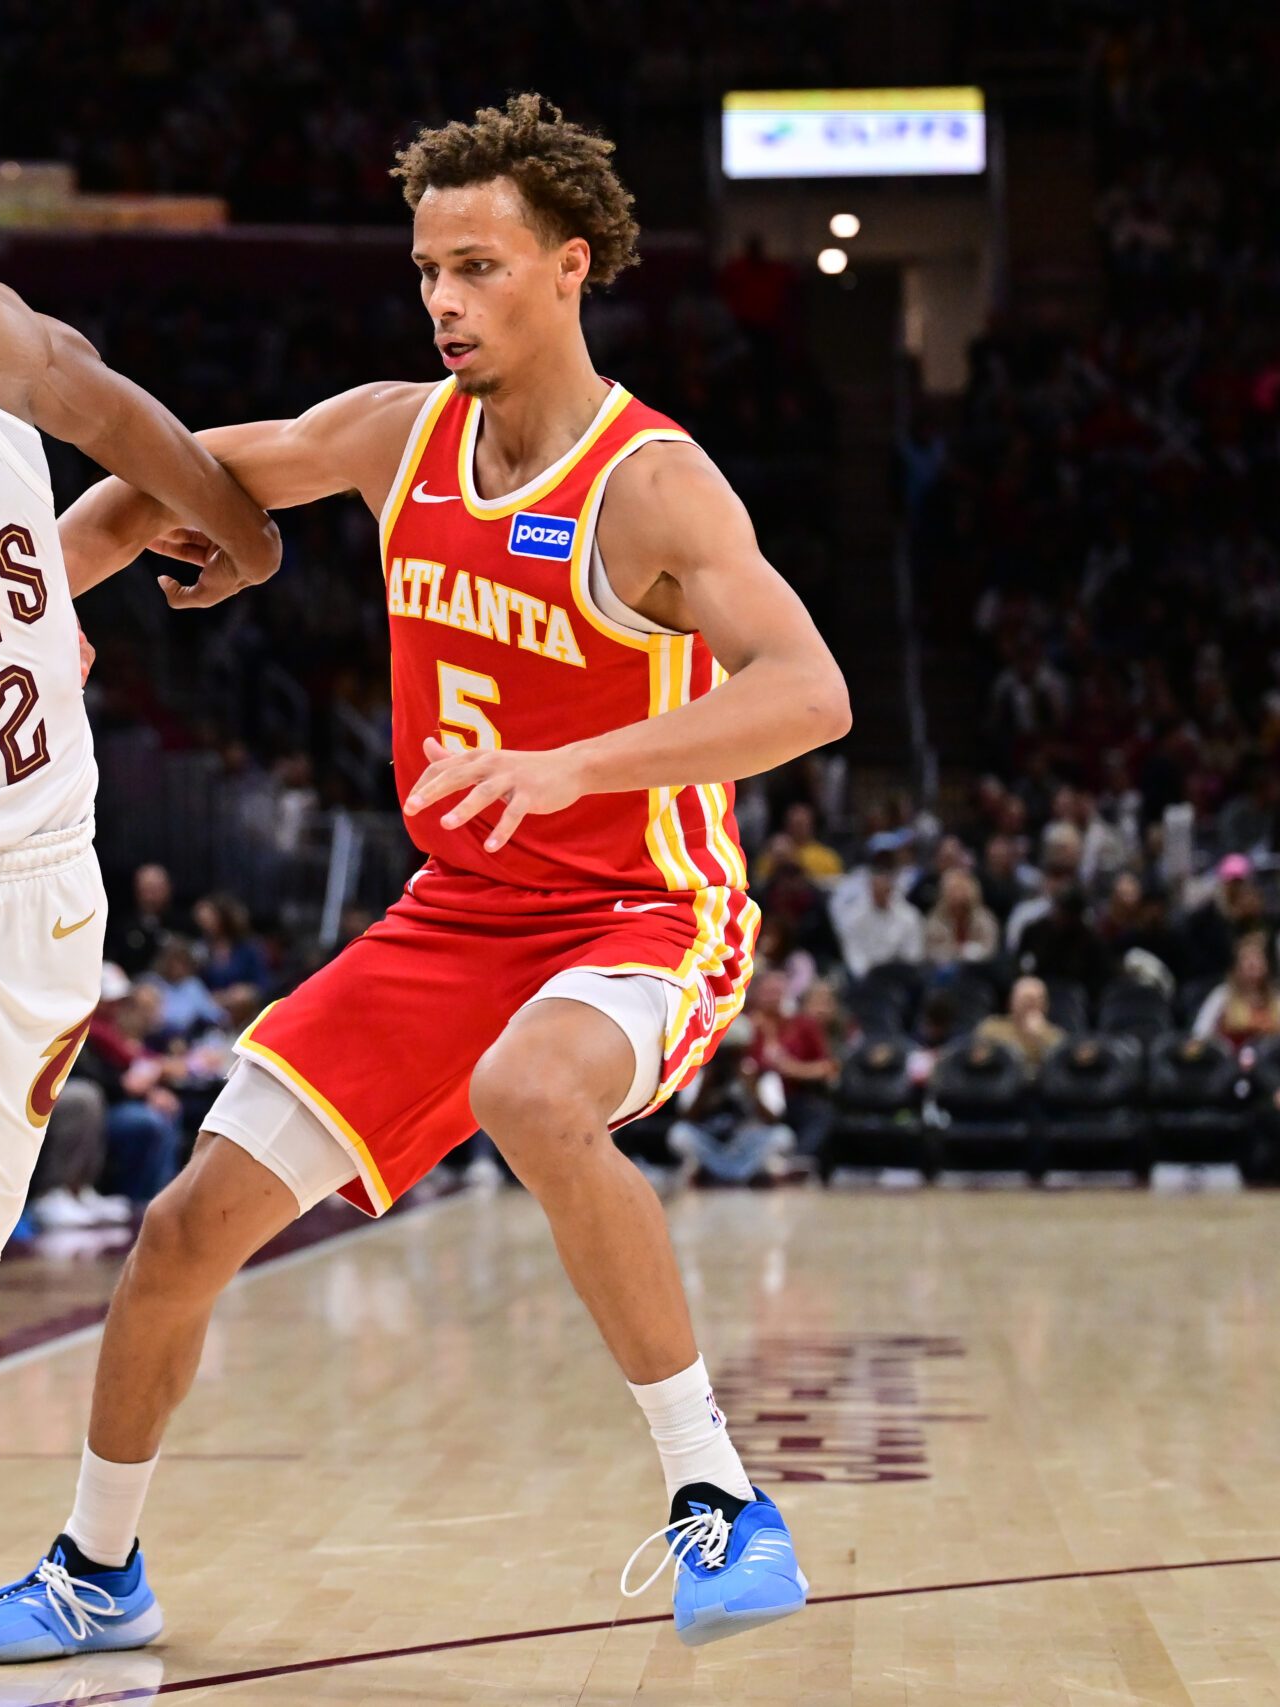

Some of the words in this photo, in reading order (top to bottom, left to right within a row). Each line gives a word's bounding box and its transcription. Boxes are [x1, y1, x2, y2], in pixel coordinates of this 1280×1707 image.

[516, 524, 570, 547] paze
[389, 557, 587, 669] ATLANTA
[436, 659, 502, 752] 5
